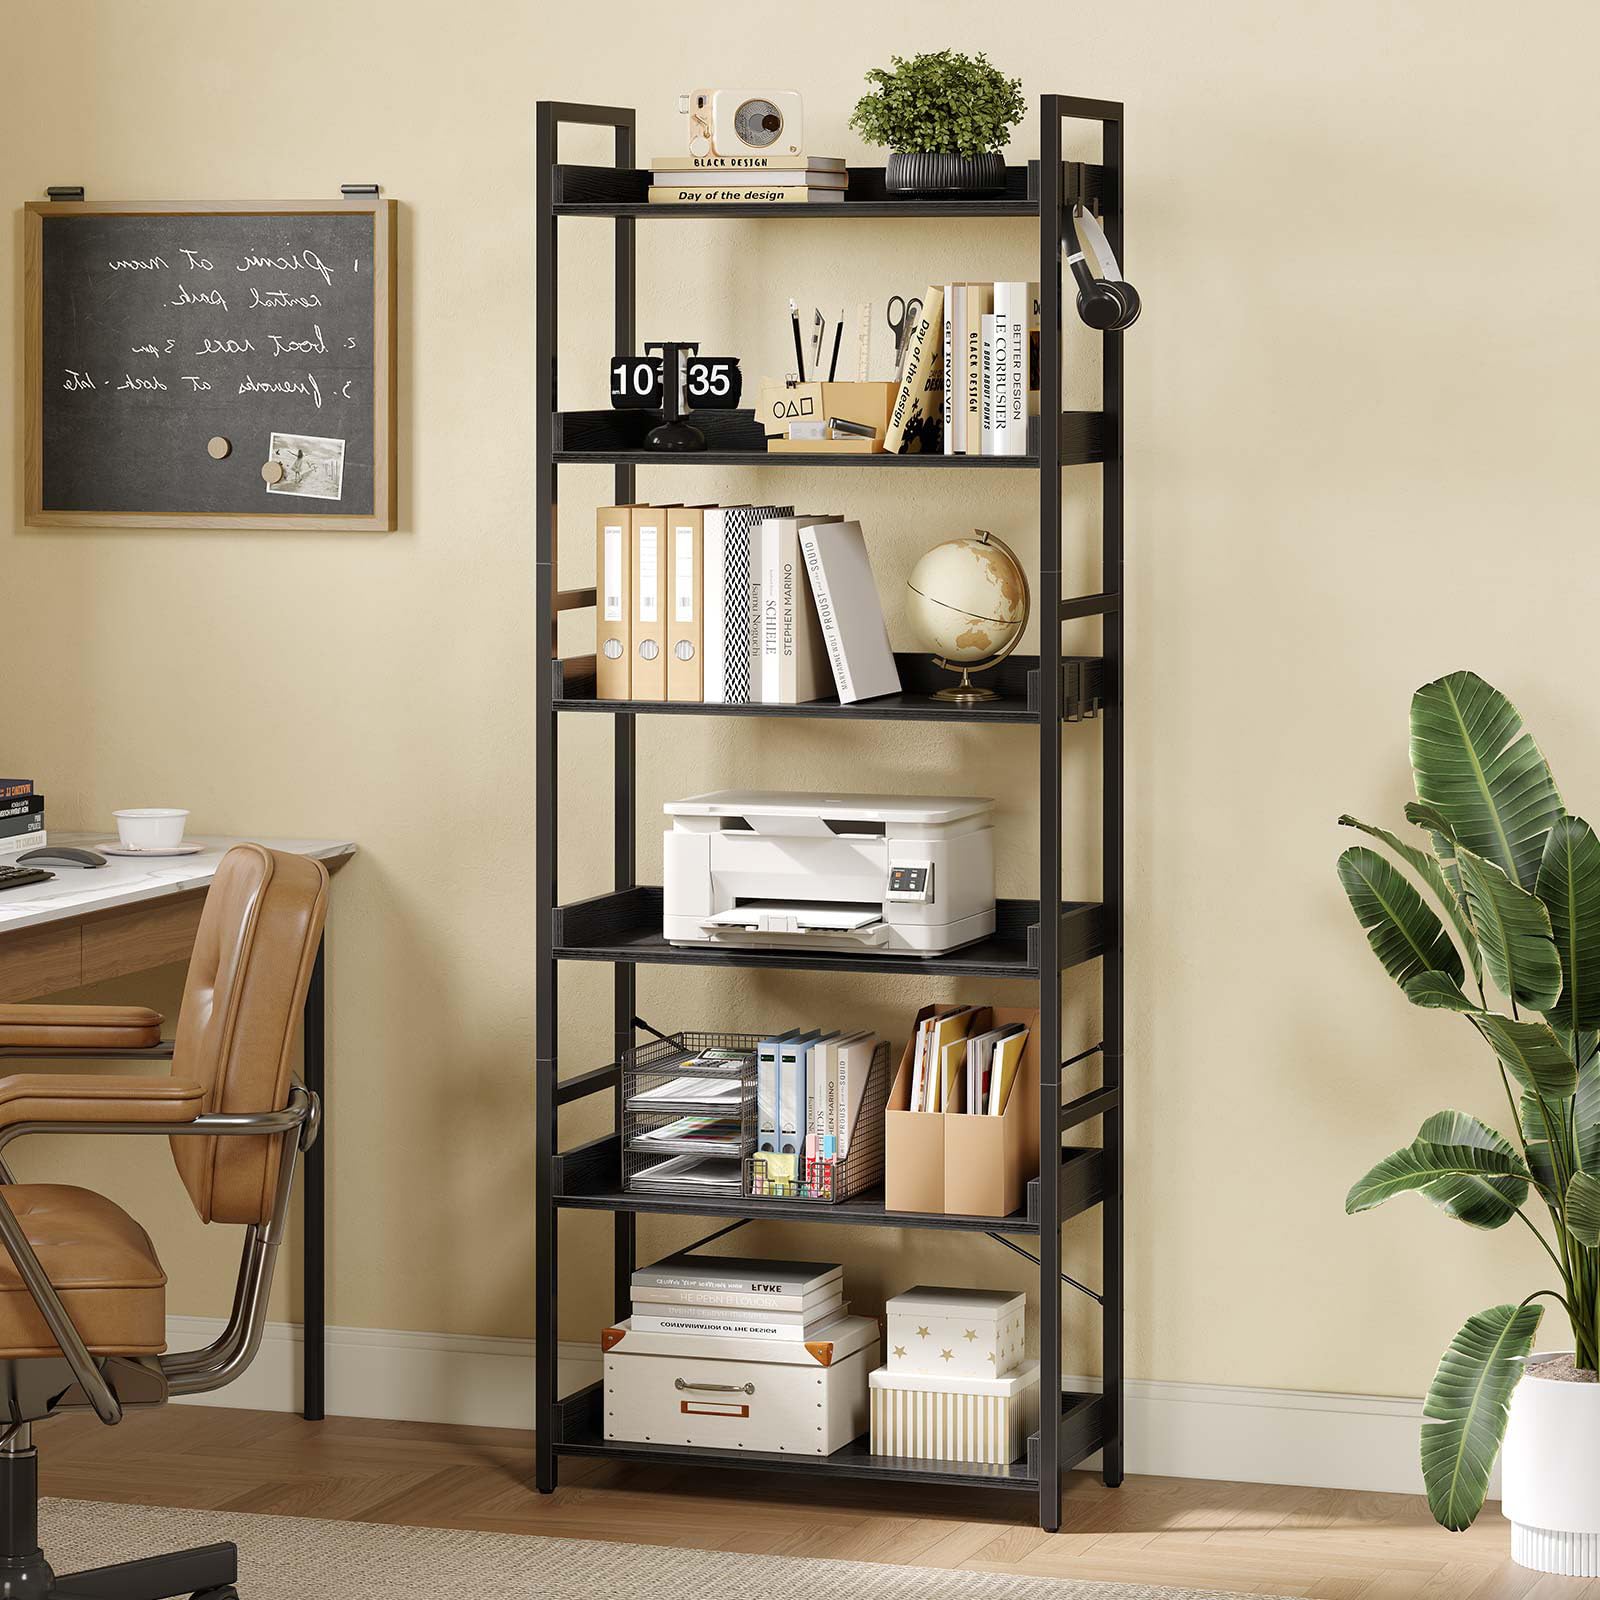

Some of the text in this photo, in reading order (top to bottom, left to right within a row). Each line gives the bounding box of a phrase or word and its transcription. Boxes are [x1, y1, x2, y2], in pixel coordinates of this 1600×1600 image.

[694, 158, 768, 168] BLACK DESIGN
[678, 190, 785, 202] Day of the design
[893, 319, 930, 428] Day of the design
[969, 332, 978, 413] BLACK DESIGN
[983, 350, 991, 372] BOOK
[995, 314, 1007, 429] LE CORBUSIER
[1012, 324, 1022, 420] BETTER DESIGN
[613, 363, 654, 396] 10
[688, 363, 731, 396] 35
[983, 374, 991, 399] ABOUT
[983, 403, 991, 430] POINTS
[804, 541, 820, 573] SQUID
[751, 582, 761, 657] Isamu Noguchi
[765, 599, 777, 655] SCHIELE
[783, 563, 793, 656] STEPHEN MARINO
[817, 592, 835, 631] PROUST
